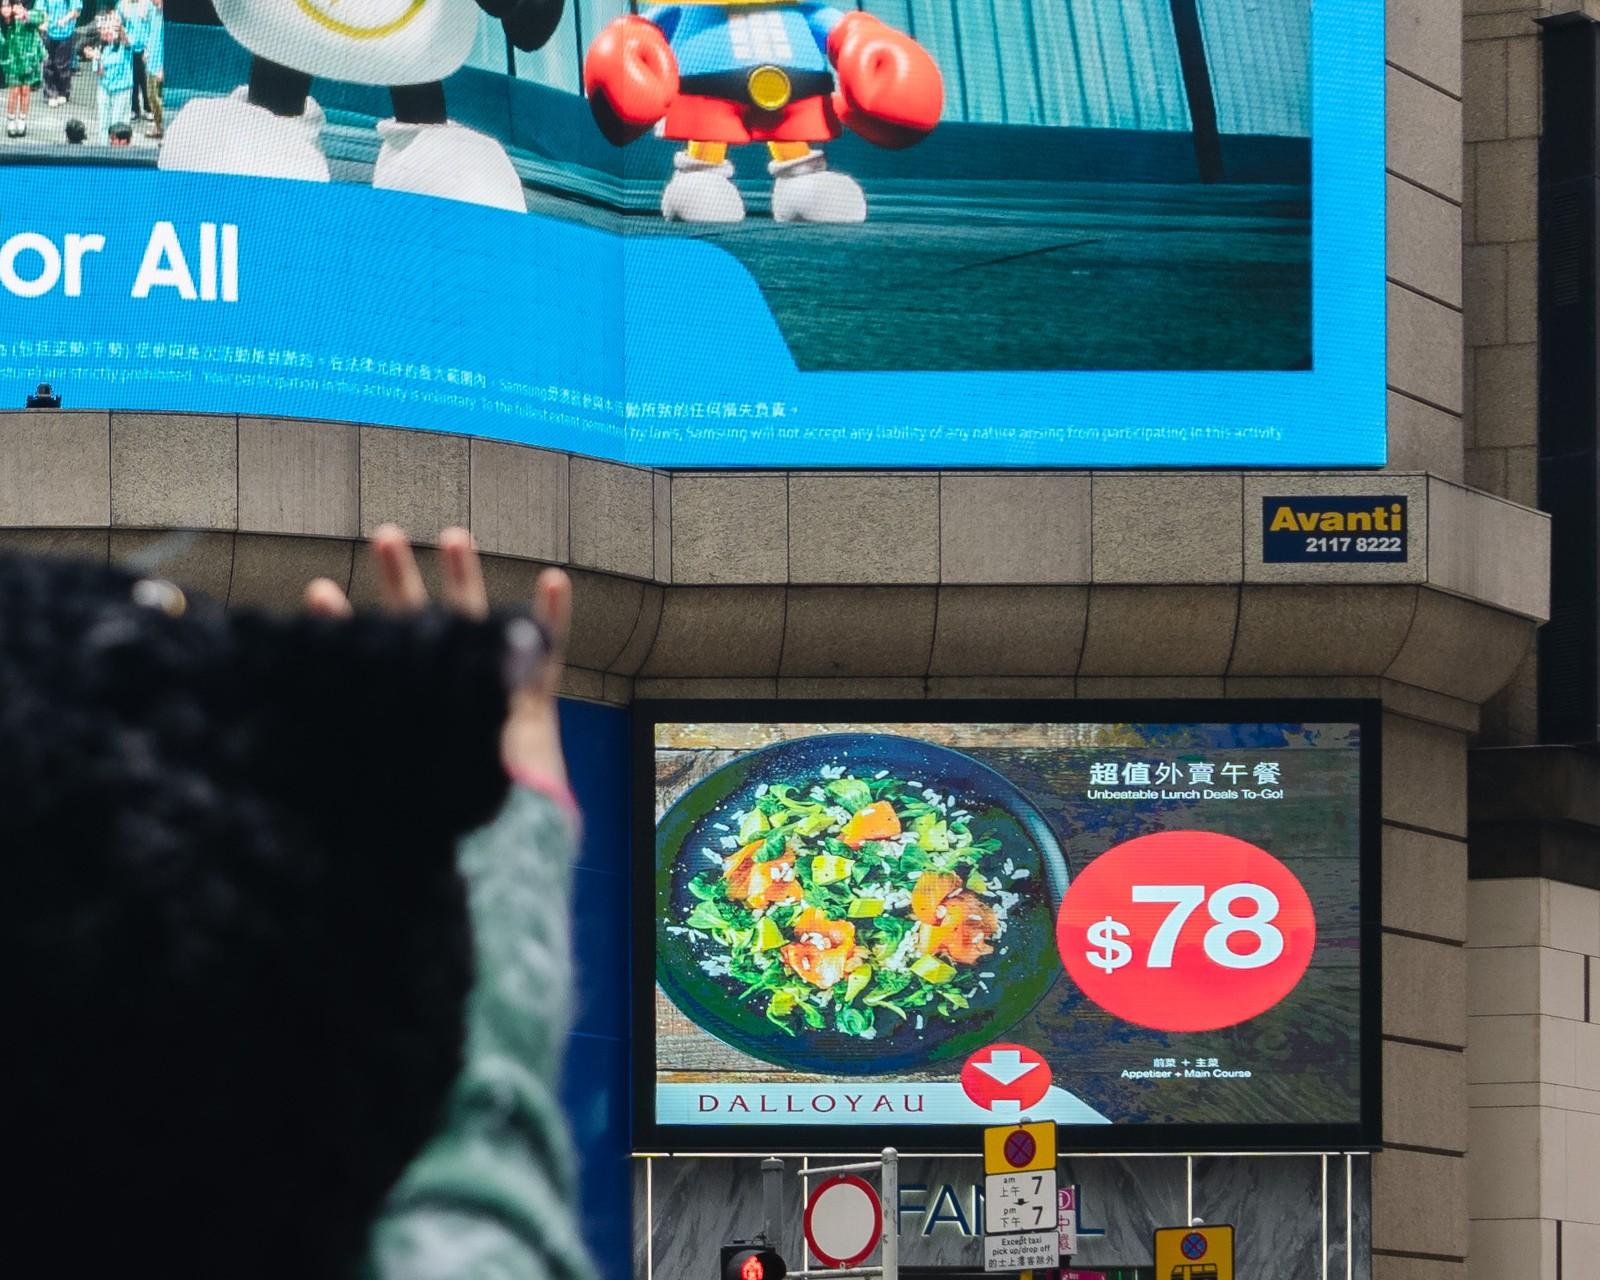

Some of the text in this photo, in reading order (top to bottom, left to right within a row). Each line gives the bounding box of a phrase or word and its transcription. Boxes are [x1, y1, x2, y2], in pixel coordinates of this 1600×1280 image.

[130, 221, 239, 303] All
[1269, 503, 1402, 532] Avanti
[1305, 537, 1402, 552] 2117 8222
[1089, 761, 1282, 786] 超值外賣午餐
[1087, 788, 1284, 800] Unbeatable Lunch Deals To-Go!
[1085, 882, 1285, 975] $78
[1184, 1069, 1211, 1078] Main
[1212, 1069, 1252, 1078] Course
[698, 1094, 925, 1113] DALLOYAU
[1000, 1186, 1020, 1198] 上午
[1031, 1175, 1043, 1195] 7
[1000, 1217, 1021, 1228] 下午
[1003, 1206, 1044, 1226] pm 7
[1001, 1236, 1042, 1246] Except taxi
[992, 1247, 1008, 1257] pick
[1039, 1244, 1051, 1253] off
